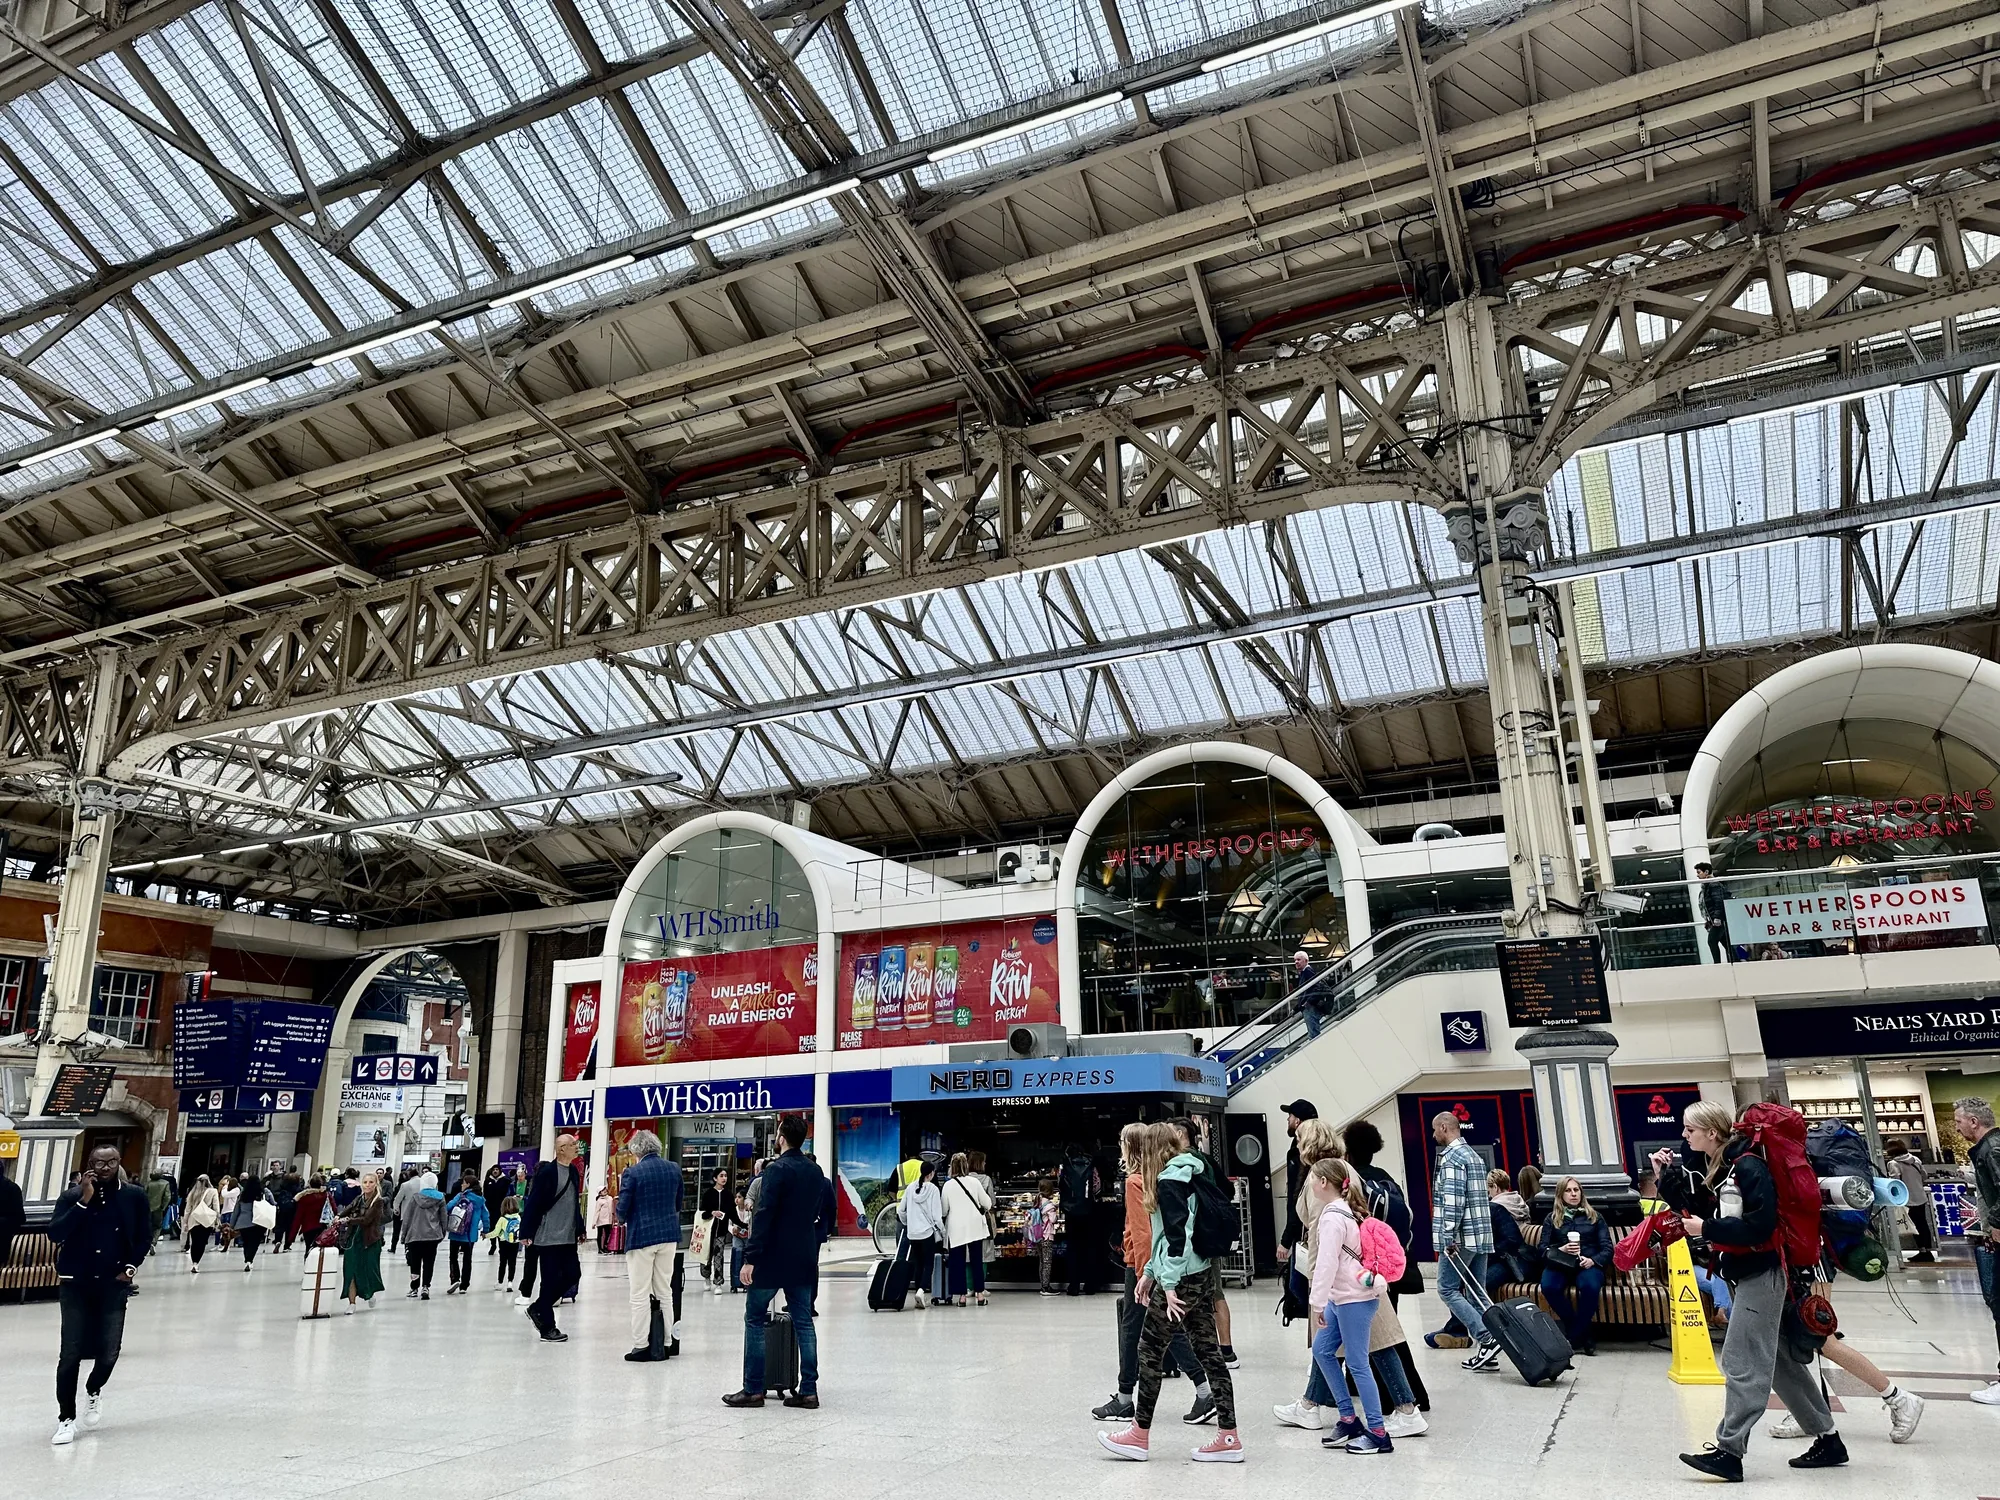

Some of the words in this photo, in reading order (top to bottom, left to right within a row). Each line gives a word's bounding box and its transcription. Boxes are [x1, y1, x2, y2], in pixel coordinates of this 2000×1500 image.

[1726, 788, 1995, 832] WETHERSPOONS
[1107, 827, 1315, 867] WETHERSPOONS
[1757, 836, 1798, 854] BAR
[1808, 834, 1821, 849] &
[1831, 818, 1973, 848] RESTAURANT
[1744, 886, 1966, 918] WETHERSPOONS
[657, 904, 780, 940] WHSmith
[1767, 923, 1801, 936] BAR
[1812, 921, 1823, 932] &
[1833, 911, 1950, 931] RESTAURANT
[711, 982, 771, 998] UNLEASH
[877, 970, 905, 1003] RAW
[905, 967, 933, 1001] RAW
[935, 968, 958, 998] RAW
[990, 959, 1032, 1006] RAW
[730, 998, 739, 1010] A
[777, 993, 795, 1006] OF
[995, 1004, 1028, 1022] ENERGY
[708, 1012, 738, 1026] RAW
[742, 1006, 795, 1023] ENERGY
[1853, 1016, 1923, 1031] NEAL'S
[1926, 1012, 1985, 1028] YARD
[1910, 1031, 1950, 1042] Ethical
[1954, 1029, 2000, 1042] Organic
[930, 1068, 1012, 1092] NERO
[1023, 1070, 1115, 1088] EXPRESS
[341, 1091, 391, 1101] EXCHANGE
[641, 1080, 773, 1115] WHSmith
[992, 1097, 1032, 1106] ESPRESSO
[1034, 1096, 1050, 1104] BAR
[694, 1122, 725, 1133] WATER
